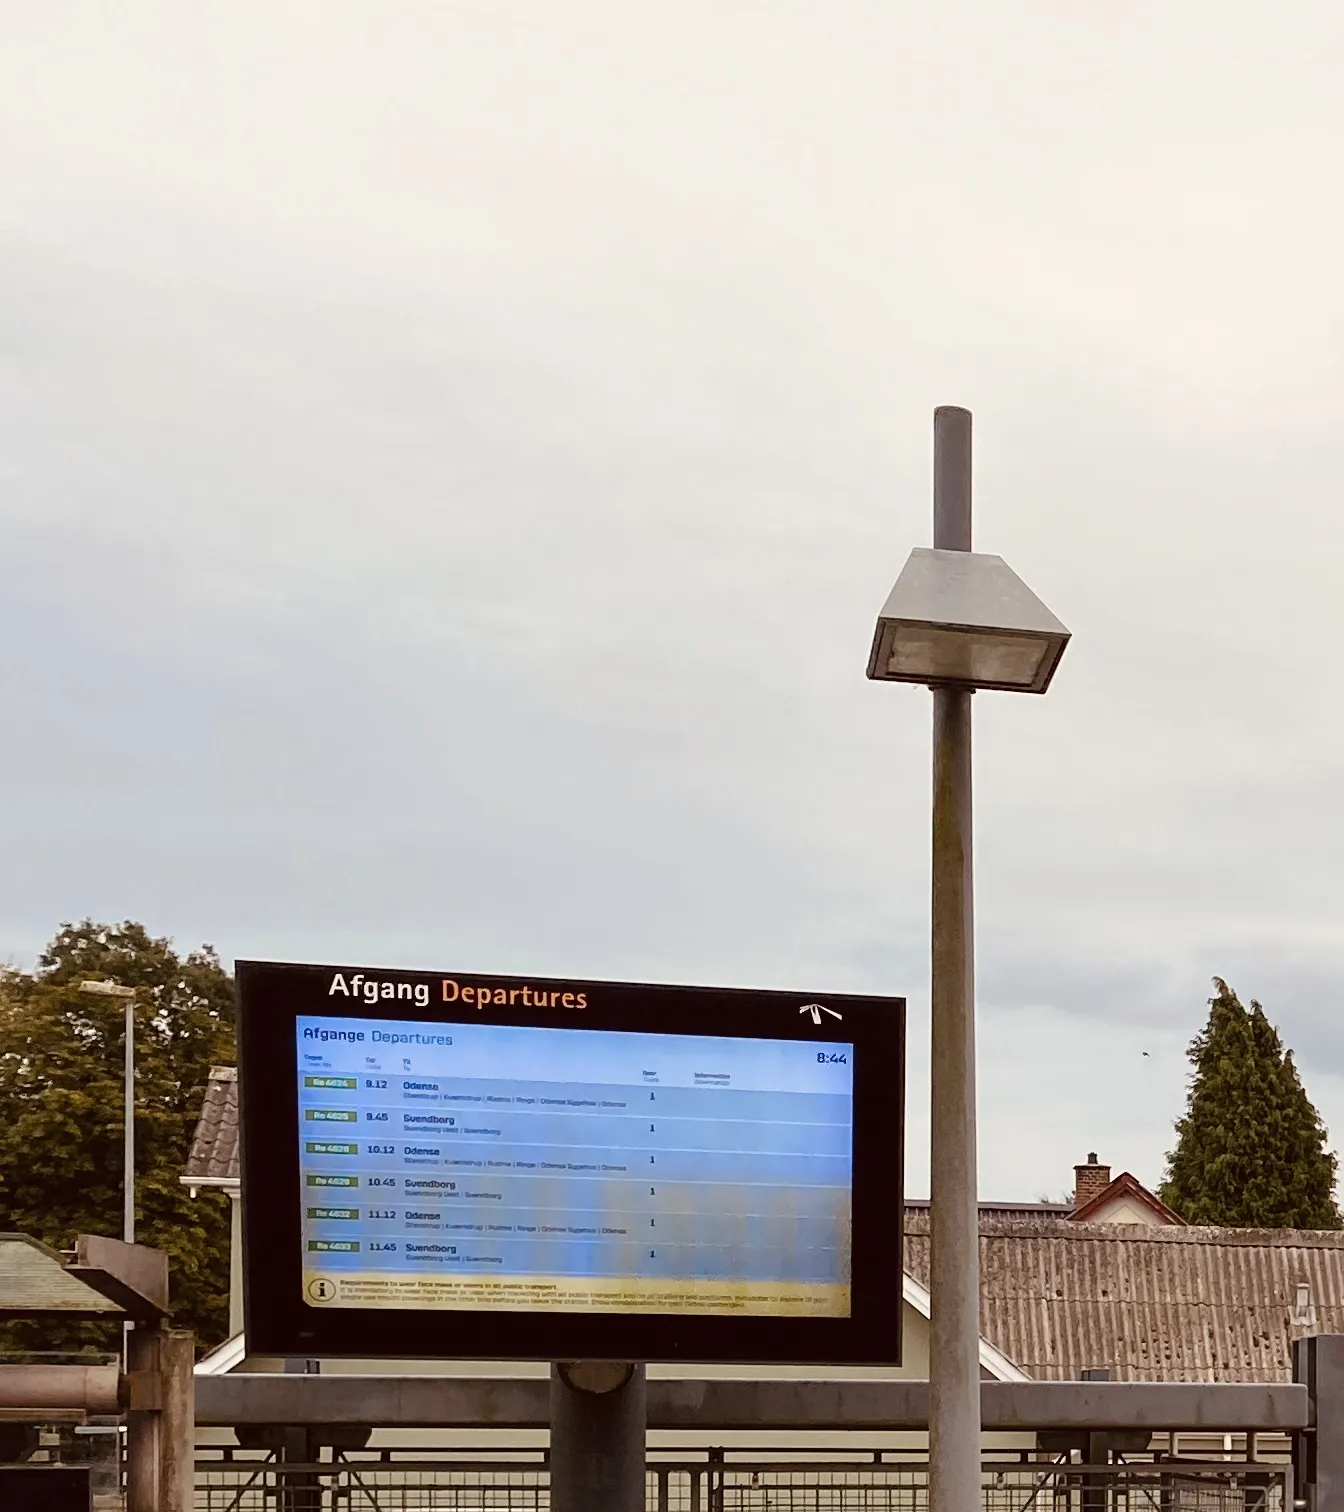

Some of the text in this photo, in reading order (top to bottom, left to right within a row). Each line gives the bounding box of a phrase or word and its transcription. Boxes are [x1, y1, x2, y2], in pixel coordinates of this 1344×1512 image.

[328, 973, 587, 1009] Afgang Departures
[303, 1027, 453, 1045] Afgange Departures
[817, 1052, 847, 1065] 8:44
[366, 1079, 388, 1089] 9.12
[403, 1081, 439, 1091] Odense
[366, 1112, 388, 1121] 9.45
[403, 1114, 455, 1126] Svendborg
[367, 1145, 395, 1154] 10.12
[404, 1146, 440, 1156] Odense
[368, 1178, 396, 1187] 10.45
[404, 1179, 456, 1190] Svendborg
[368, 1210, 396, 1219] 11.12
[405, 1211, 441, 1220] Odense
[369, 1243, 397, 1251] 11.45
[405, 1243, 457, 1254] Svendborg
